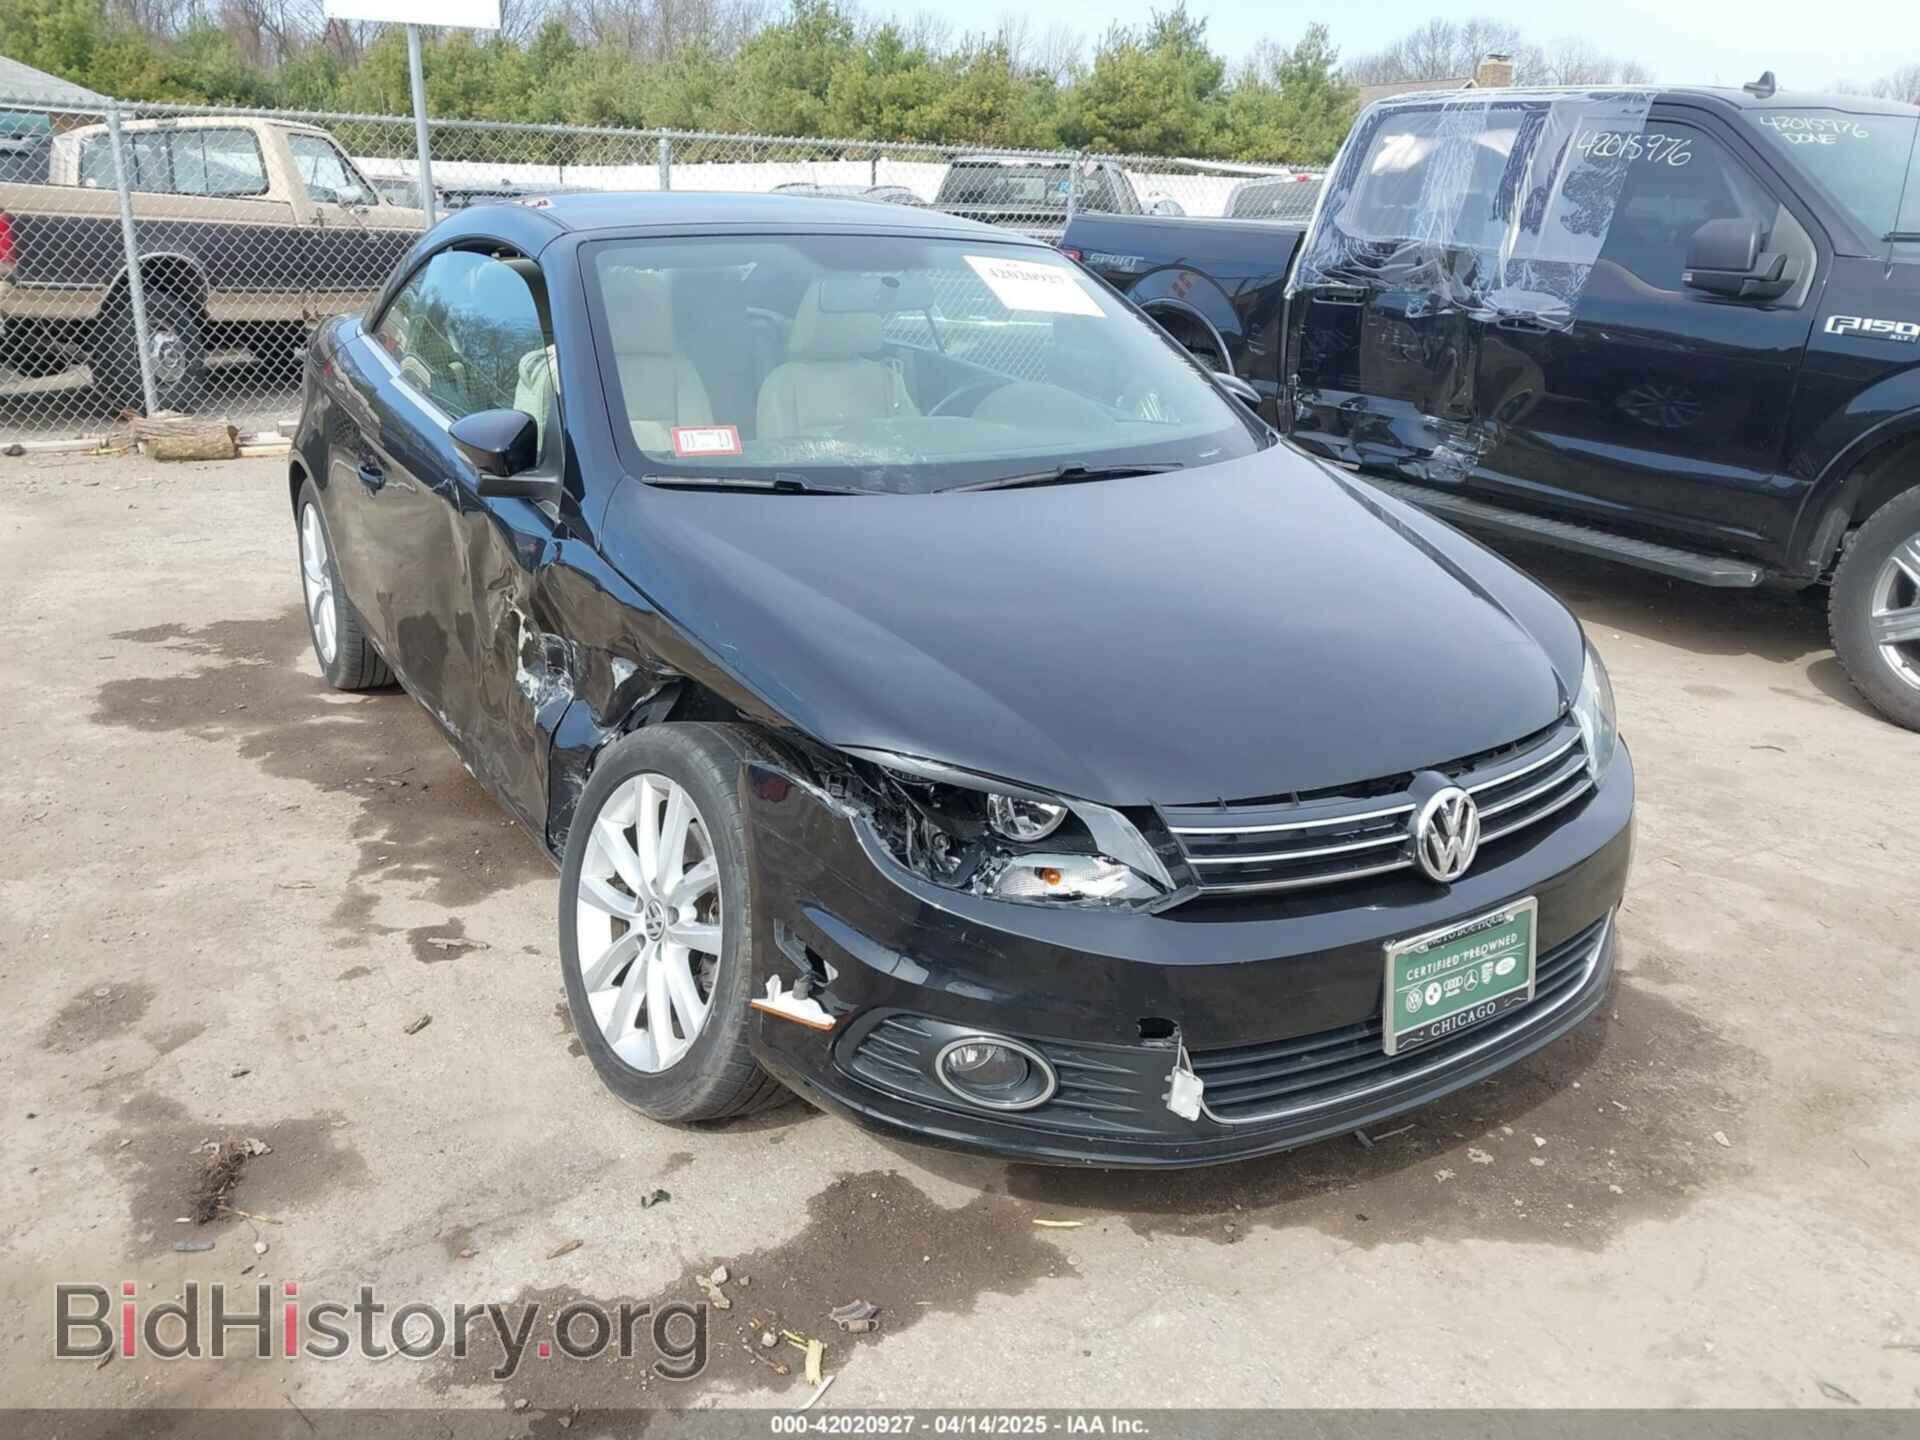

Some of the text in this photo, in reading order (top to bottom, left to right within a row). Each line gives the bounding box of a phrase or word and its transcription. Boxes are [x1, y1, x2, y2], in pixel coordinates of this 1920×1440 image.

[1576, 131, 1693, 167] 42015976
[1782, 132, 1837, 145] DONE
[1406, 954, 1460, 981] CERTIFIED
[1431, 1001, 1496, 1037] CHICAGO
